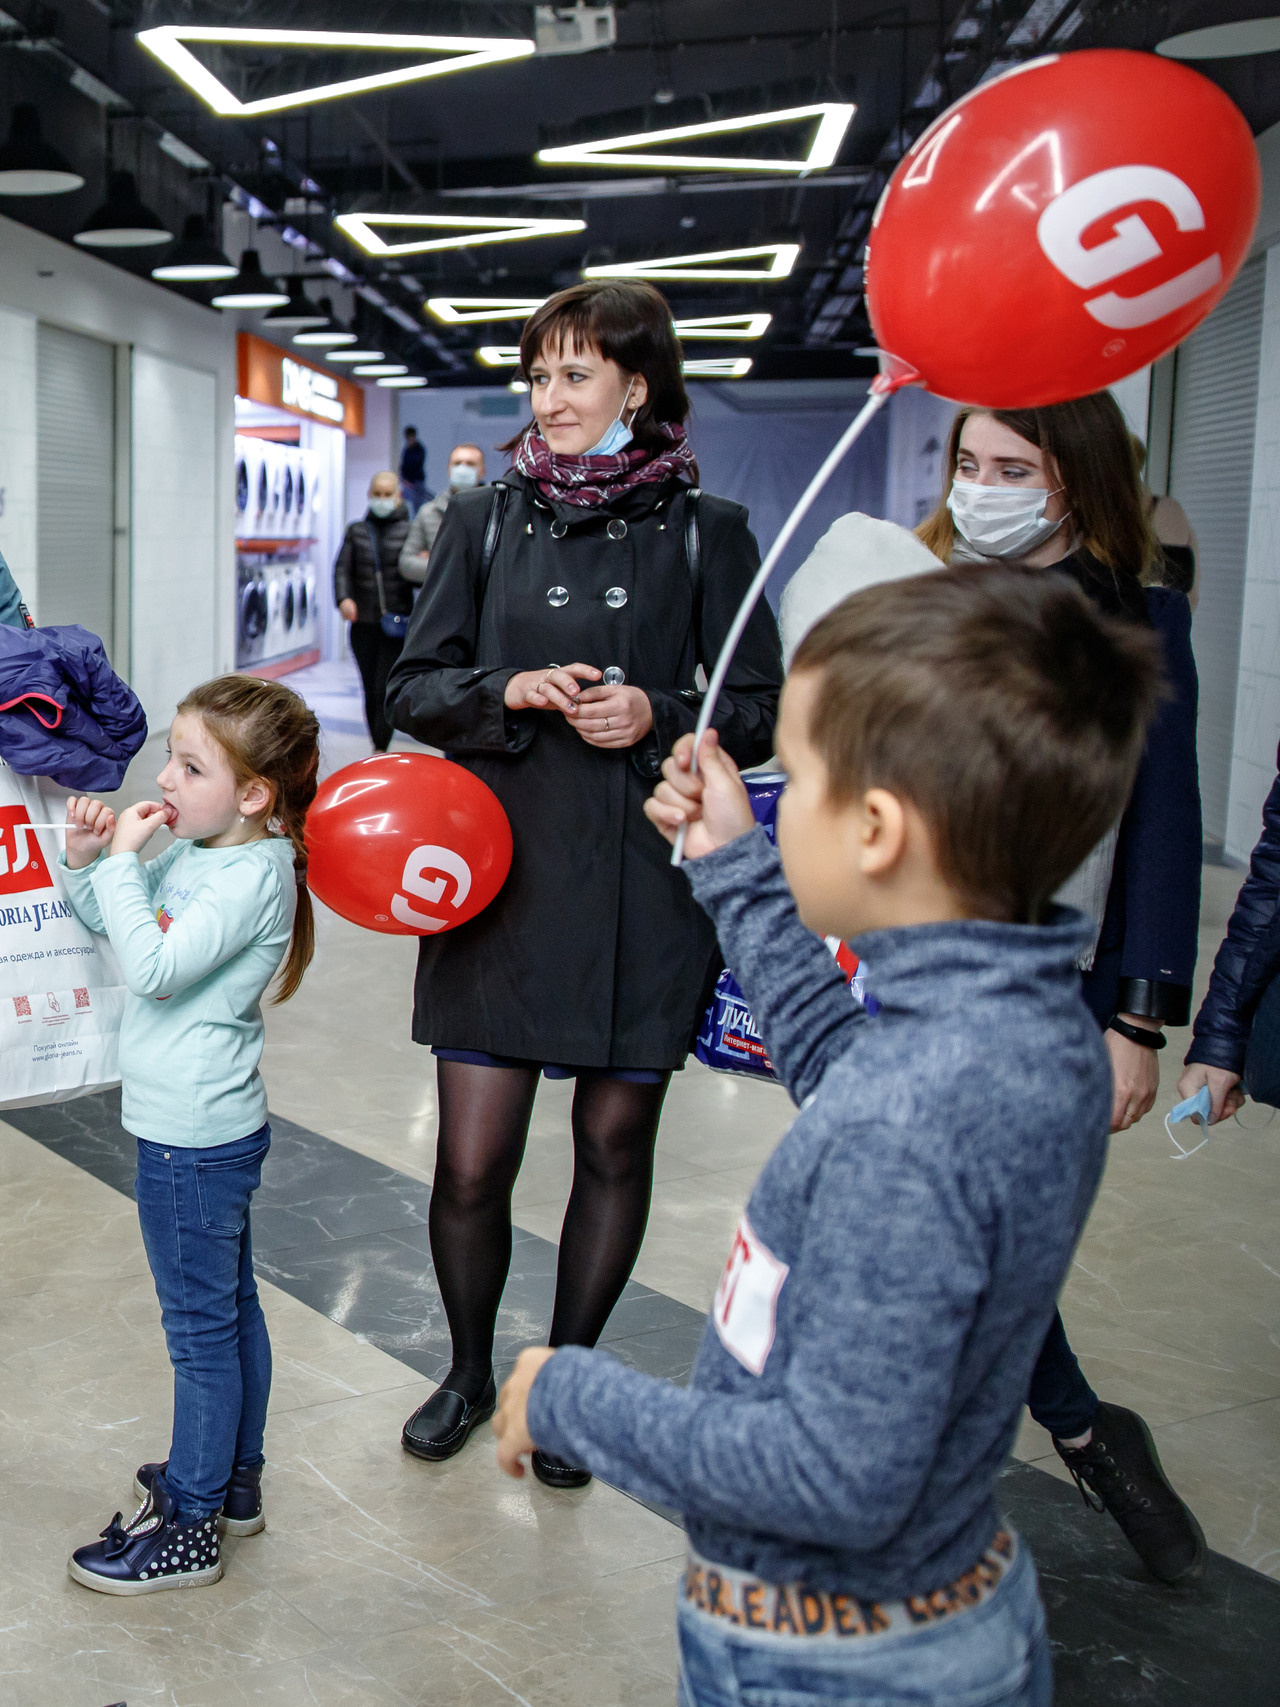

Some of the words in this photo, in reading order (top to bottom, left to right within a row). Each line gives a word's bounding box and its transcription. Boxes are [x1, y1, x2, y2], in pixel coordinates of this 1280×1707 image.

[1037, 164, 1222, 330] GJ
[391, 845, 472, 931] GJ
[32, 900, 72, 931] JEANS
[10, 950, 45, 963] одежда
[33, 1042, 57, 1052] Покупай
[723, 1034, 768, 1055] Интернет-мага
